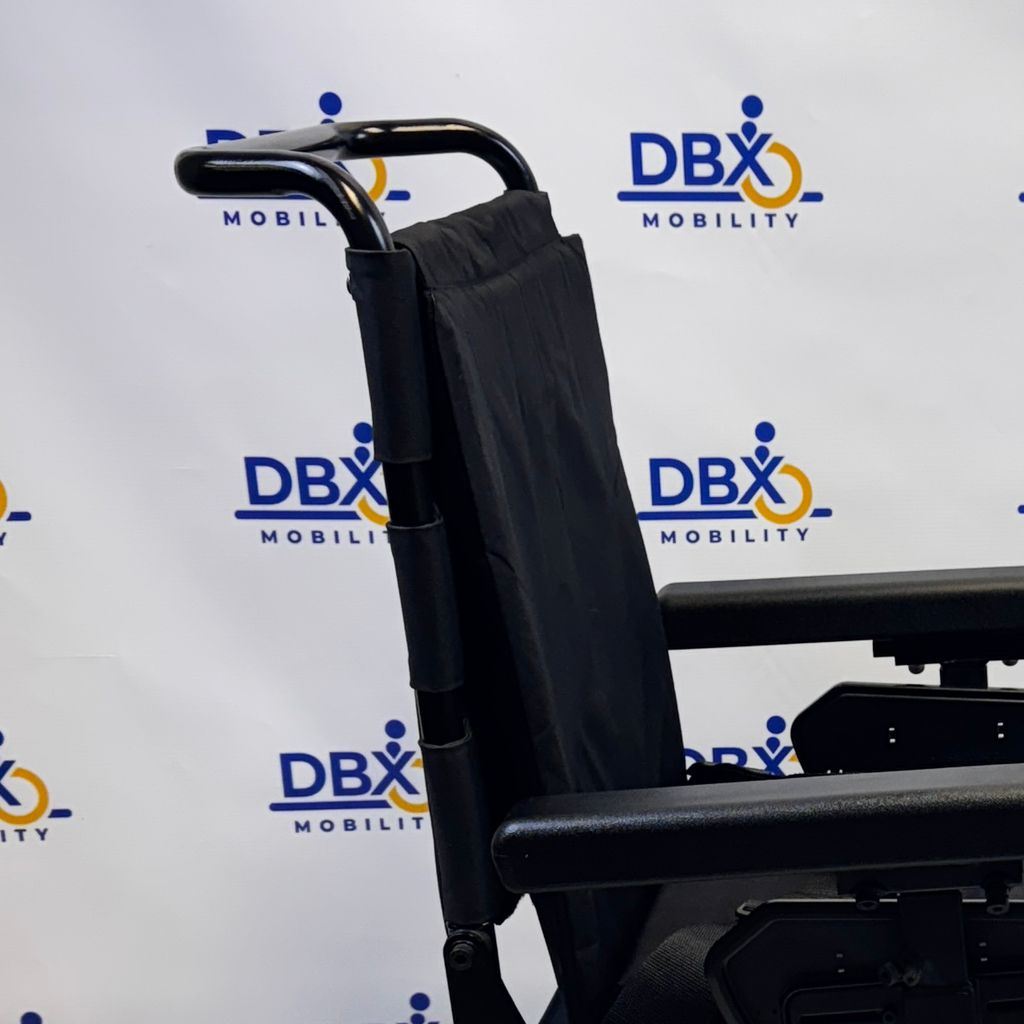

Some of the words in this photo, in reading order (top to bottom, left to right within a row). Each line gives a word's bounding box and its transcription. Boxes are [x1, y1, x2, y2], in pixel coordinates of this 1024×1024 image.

[630, 133, 774, 186] DBX
[223, 211, 340, 227] MOBIL
[643, 213, 797, 227] MOBILITY
[244, 456, 388, 506] DBX
[649, 456, 785, 506] DBX
[261, 530, 390, 544] MOBILI
[661, 529, 808, 543] MOBILITY
[280, 751, 419, 798] DBX
[294, 817, 424, 833] MOBILIT
